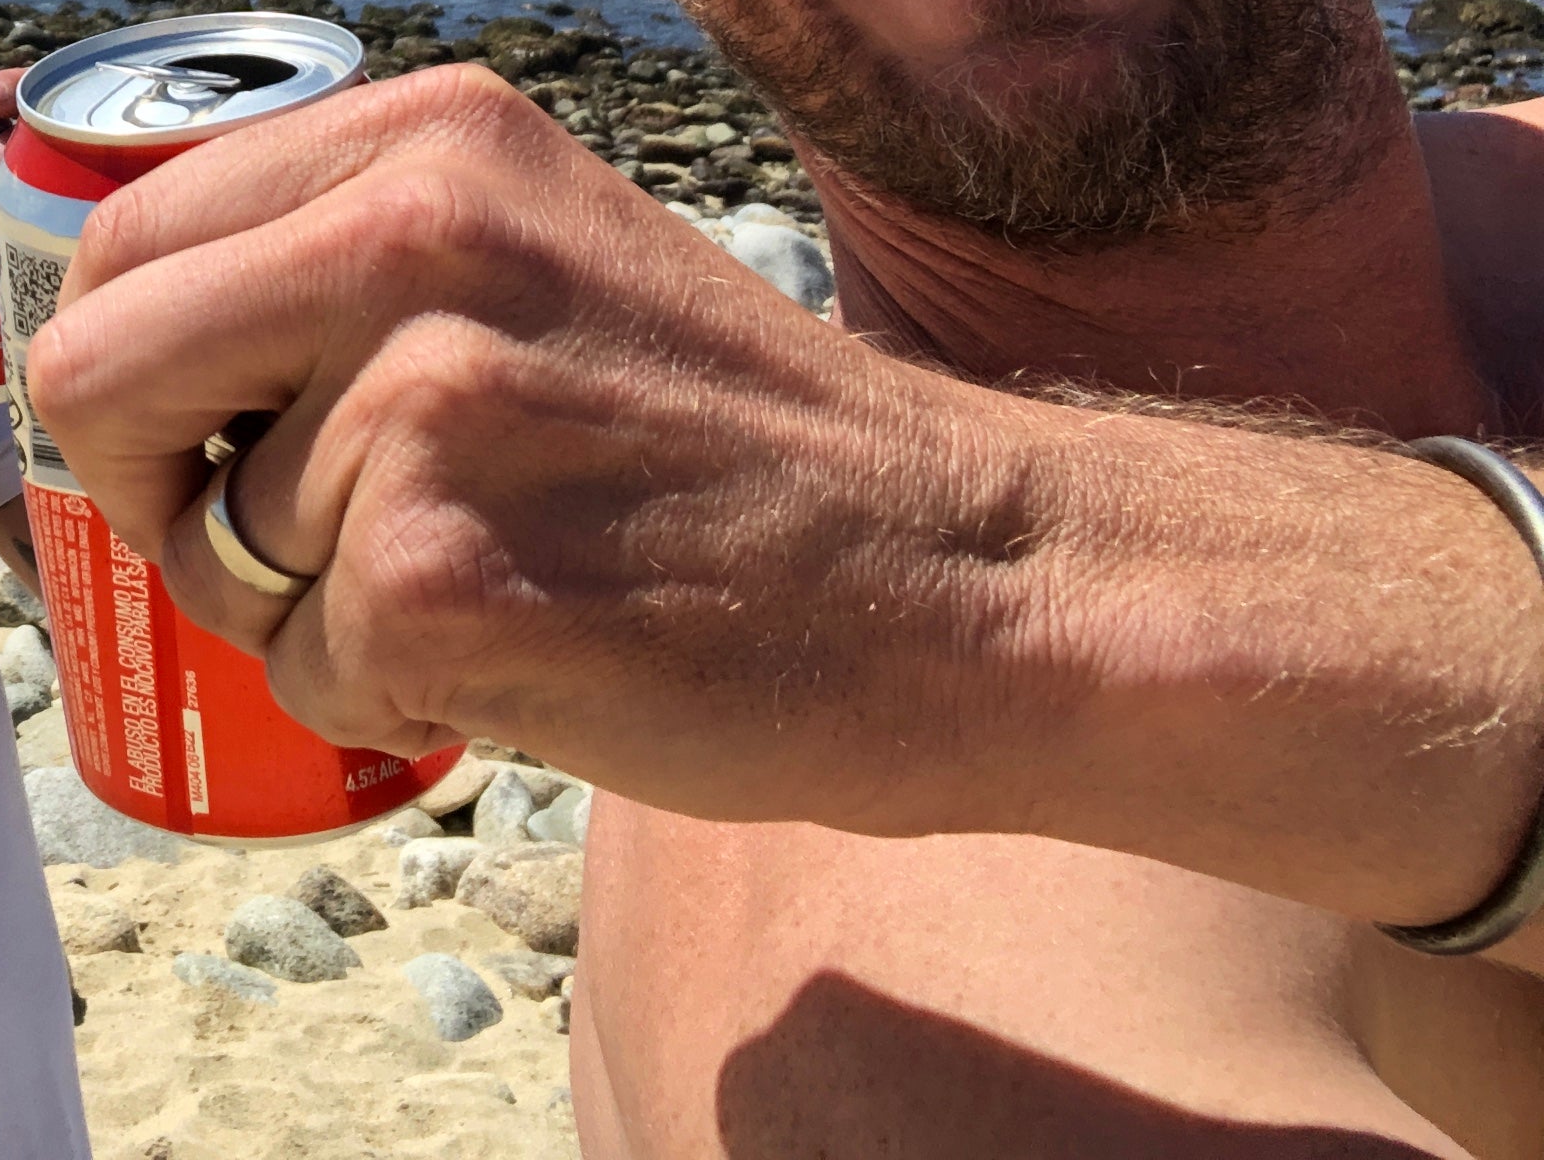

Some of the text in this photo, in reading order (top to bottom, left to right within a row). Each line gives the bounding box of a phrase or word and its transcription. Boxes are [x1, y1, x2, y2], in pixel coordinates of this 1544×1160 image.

[131, 580, 149, 600] LA
[131, 601, 151, 639] PARA
[110, 530, 147, 792] EL ABUSO EN EL CONSUMO DE EST
[134, 641, 156, 696] NOCIVO
[138, 695, 157, 716] ES
[138, 718, 163, 797] PRODUCTO
